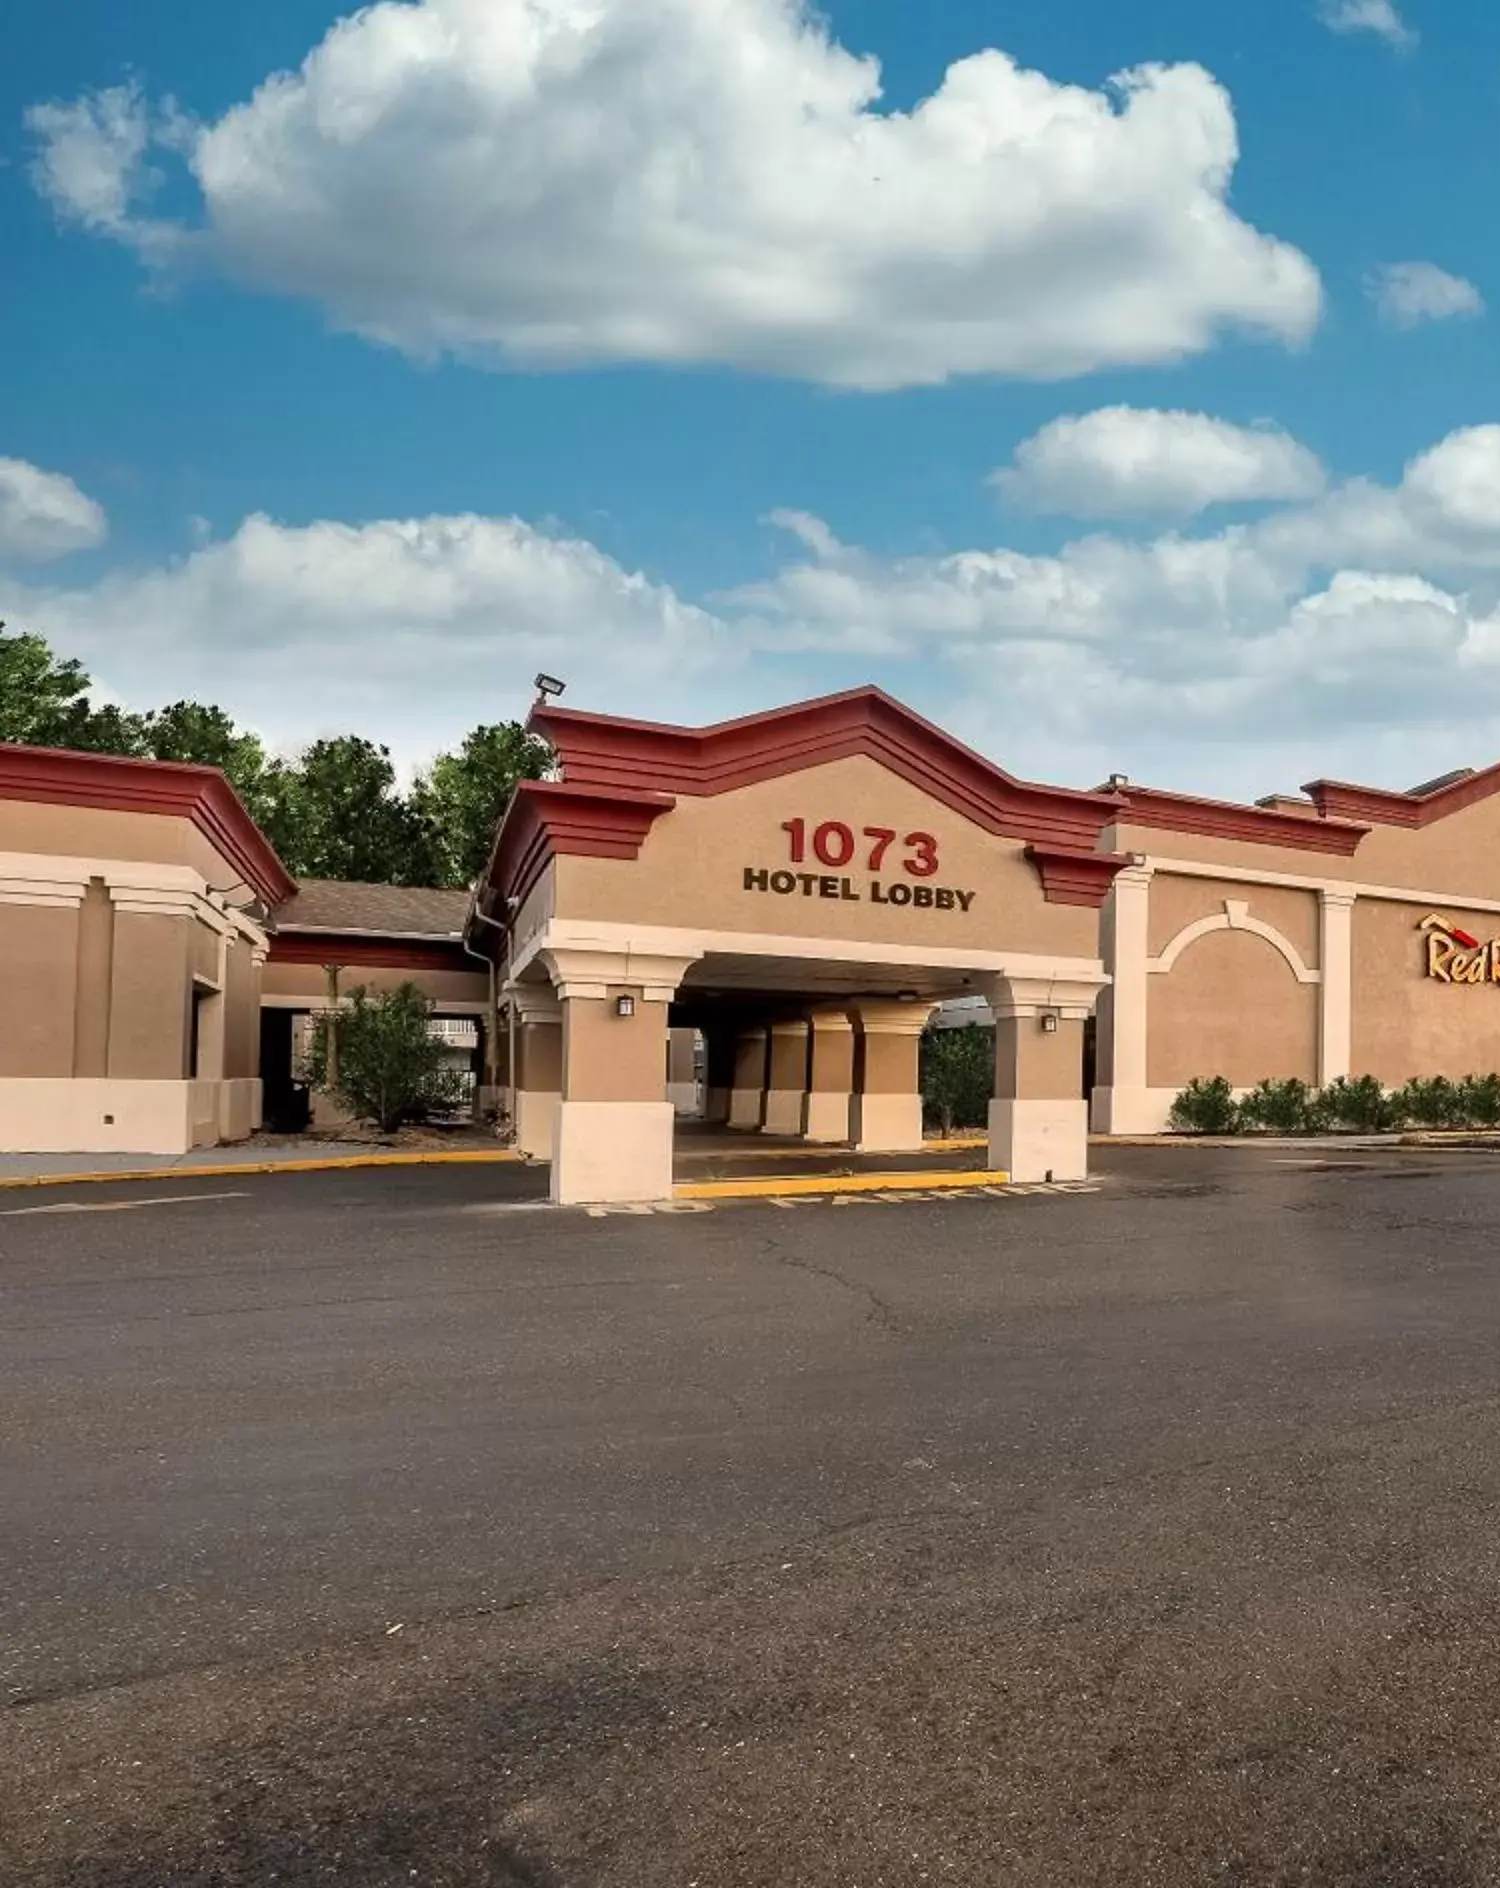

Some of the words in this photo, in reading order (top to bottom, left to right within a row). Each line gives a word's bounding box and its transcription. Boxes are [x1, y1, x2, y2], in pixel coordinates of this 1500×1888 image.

[781, 817, 939, 877] 1073
[743, 867, 860, 901] HOTEL
[871, 881, 976, 912] LOBBY
[1426, 931, 1488, 984] Red
